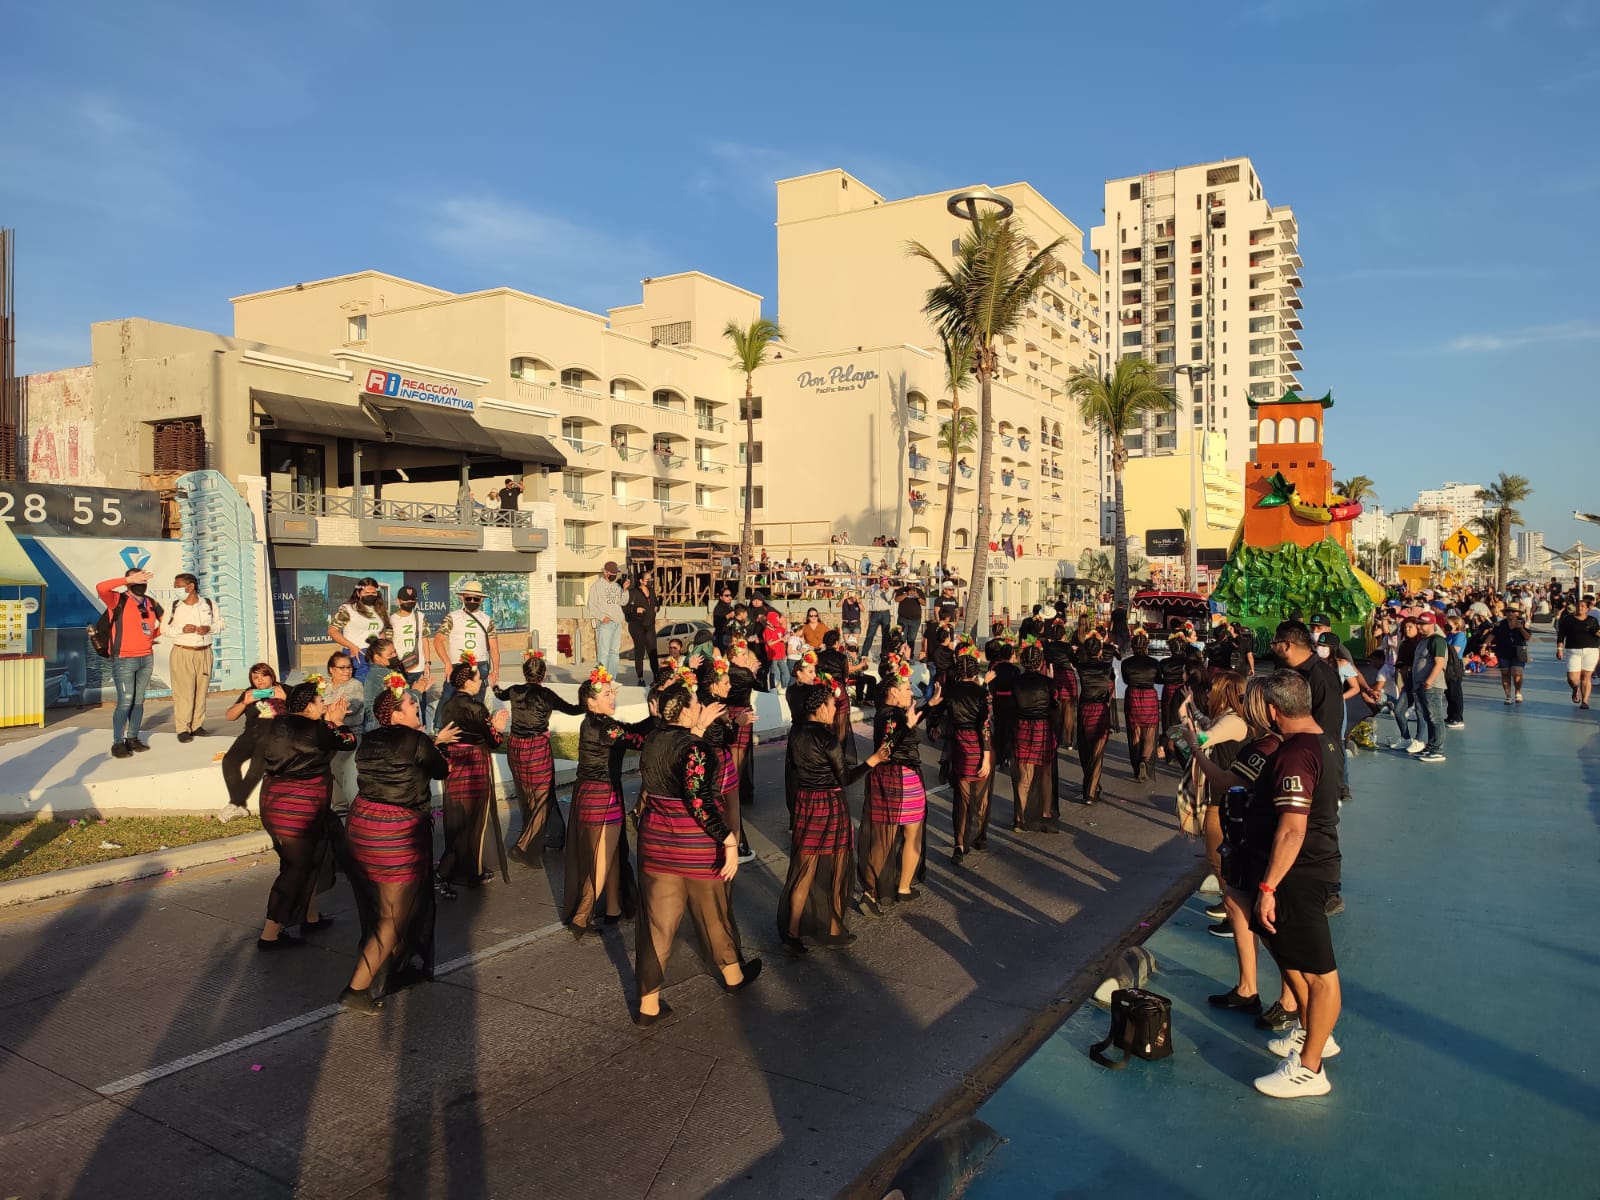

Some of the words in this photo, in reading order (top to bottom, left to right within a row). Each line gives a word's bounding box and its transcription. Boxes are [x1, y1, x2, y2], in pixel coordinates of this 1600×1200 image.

[402, 379, 457, 396] REACCIÓN
[797, 371, 827, 389] Don
[400, 388, 474, 410] INFORMATIVA
[0, 492, 47, 523] 28
[73, 496, 122, 526] 55
[273, 592, 295, 600] ERNA
[414, 601, 447, 611] ALERNA
[1248, 754, 1265, 771] 01
[1282, 776, 1303, 792] 01
